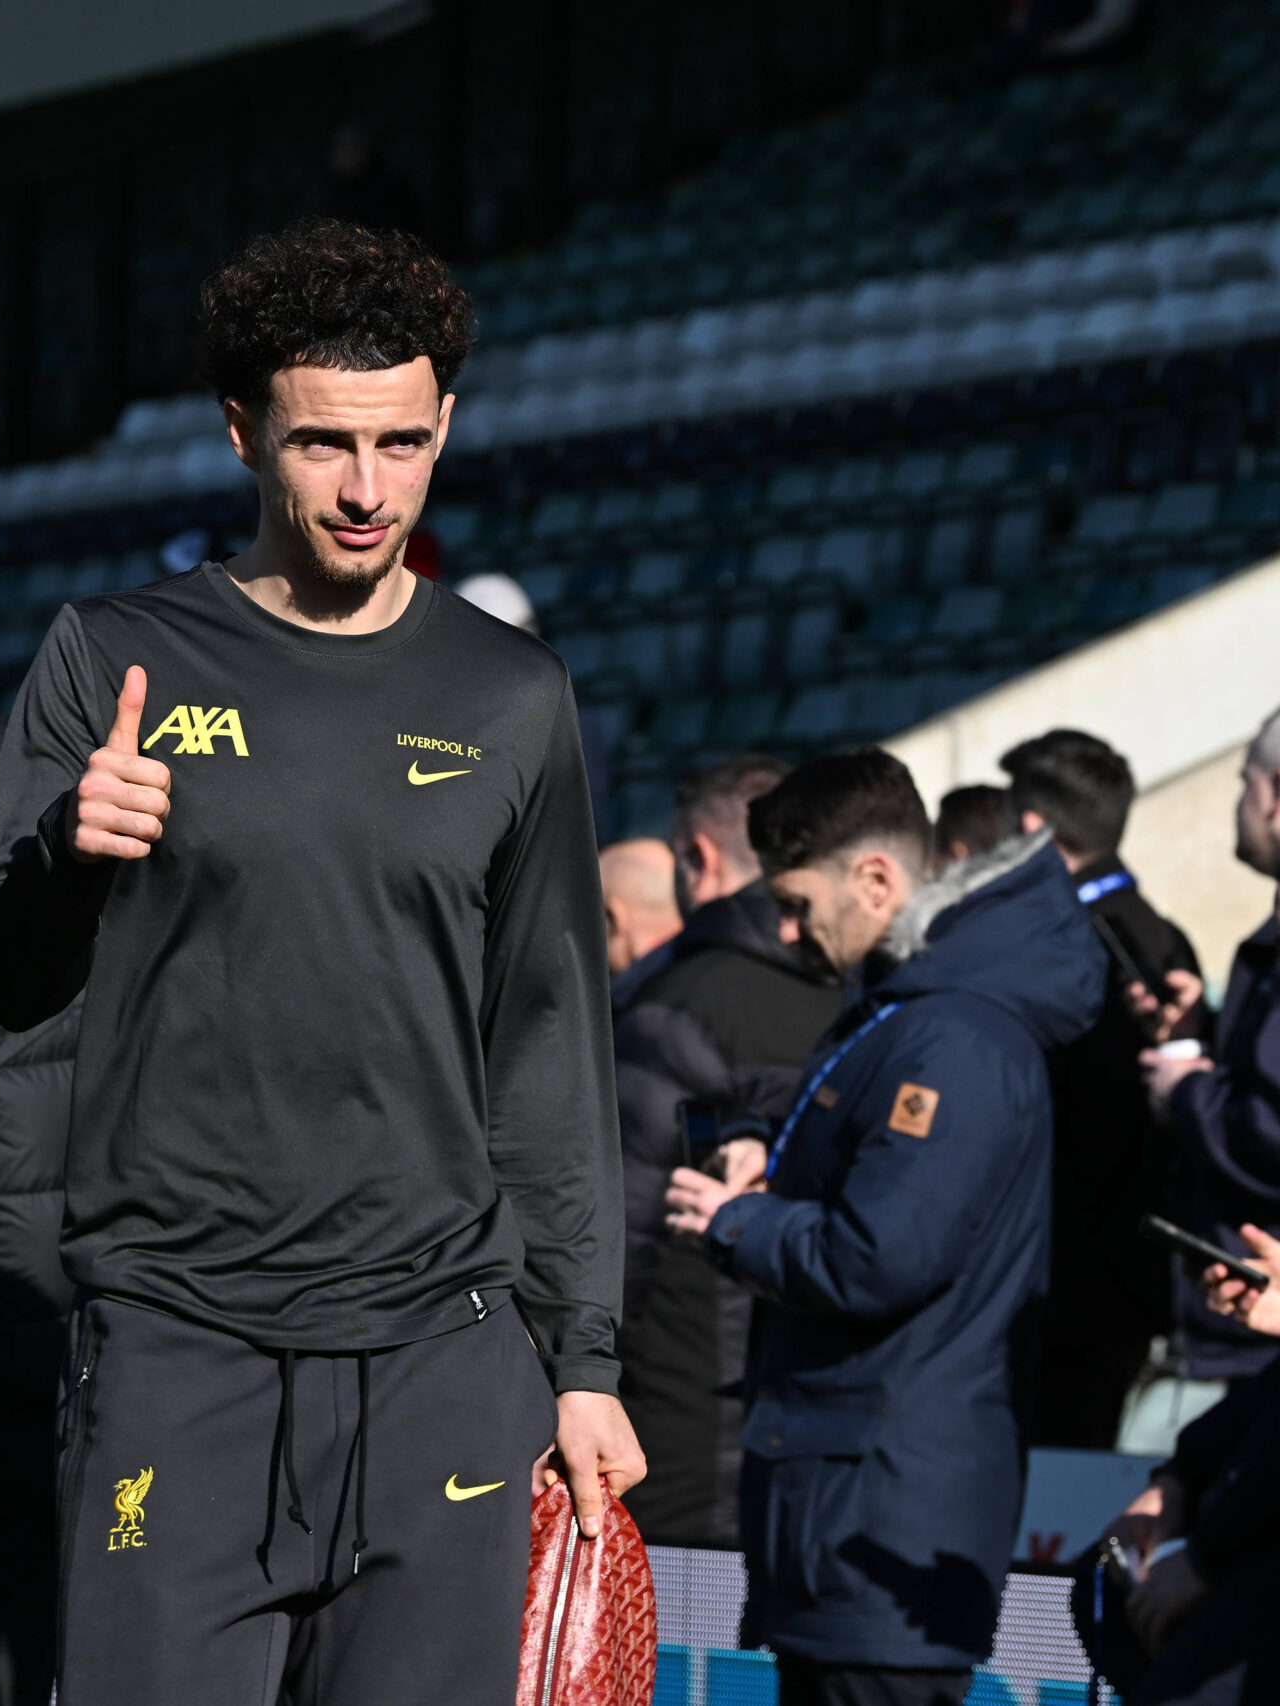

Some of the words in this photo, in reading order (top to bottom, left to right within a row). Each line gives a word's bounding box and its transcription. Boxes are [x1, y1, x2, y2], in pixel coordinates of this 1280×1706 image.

[141, 705, 250, 757] AXA
[397, 733, 464, 756] LIVERPOOL
[467, 745, 482, 760] FC
